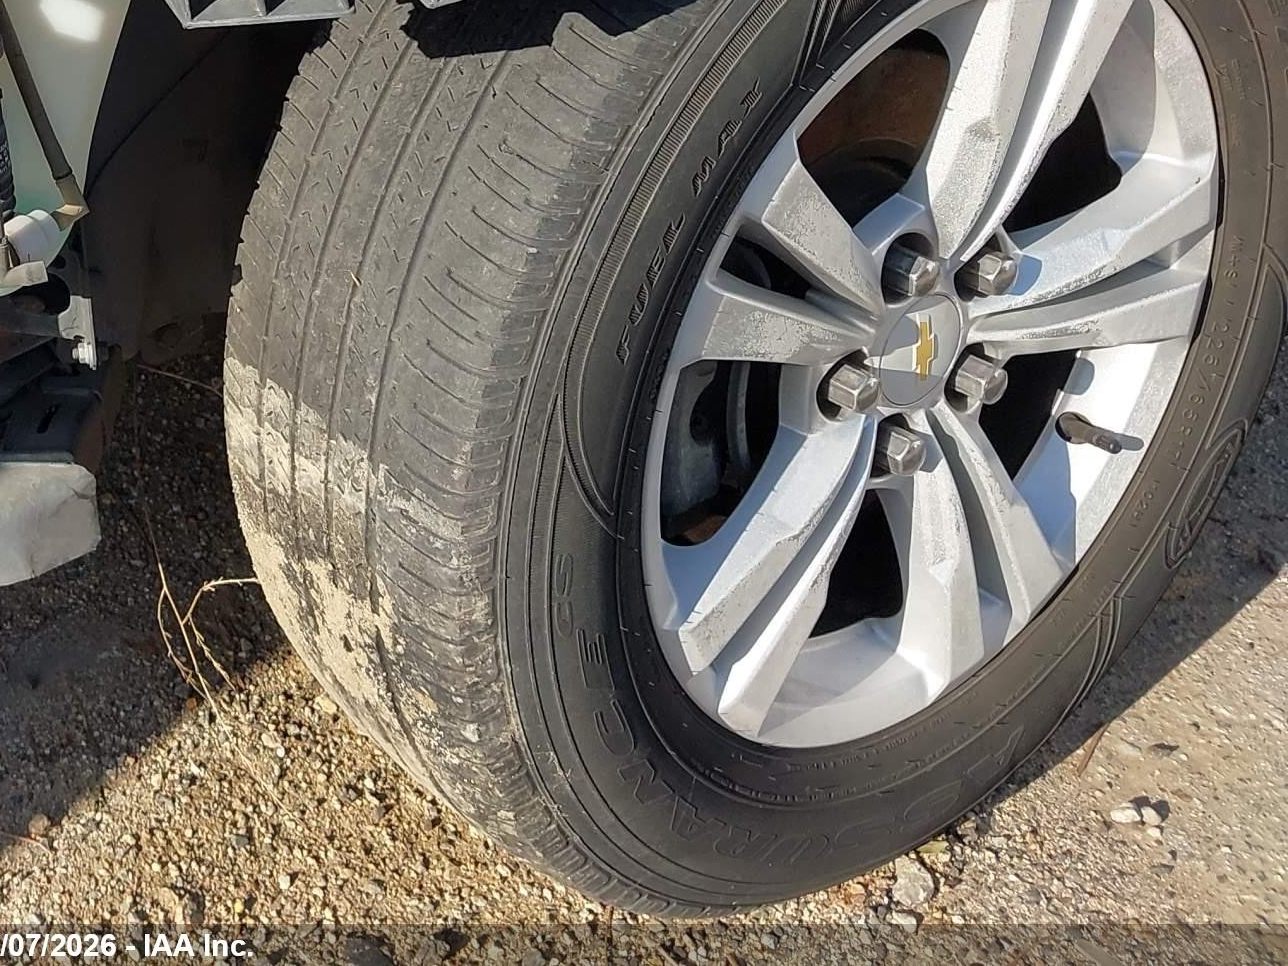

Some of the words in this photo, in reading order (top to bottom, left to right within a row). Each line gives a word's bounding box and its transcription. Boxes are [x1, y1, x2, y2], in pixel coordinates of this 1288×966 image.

[616, 213, 686, 365] FUEL
[691, 77, 762, 198] MAX
[576, 628, 1025, 866] ASSURANCE
